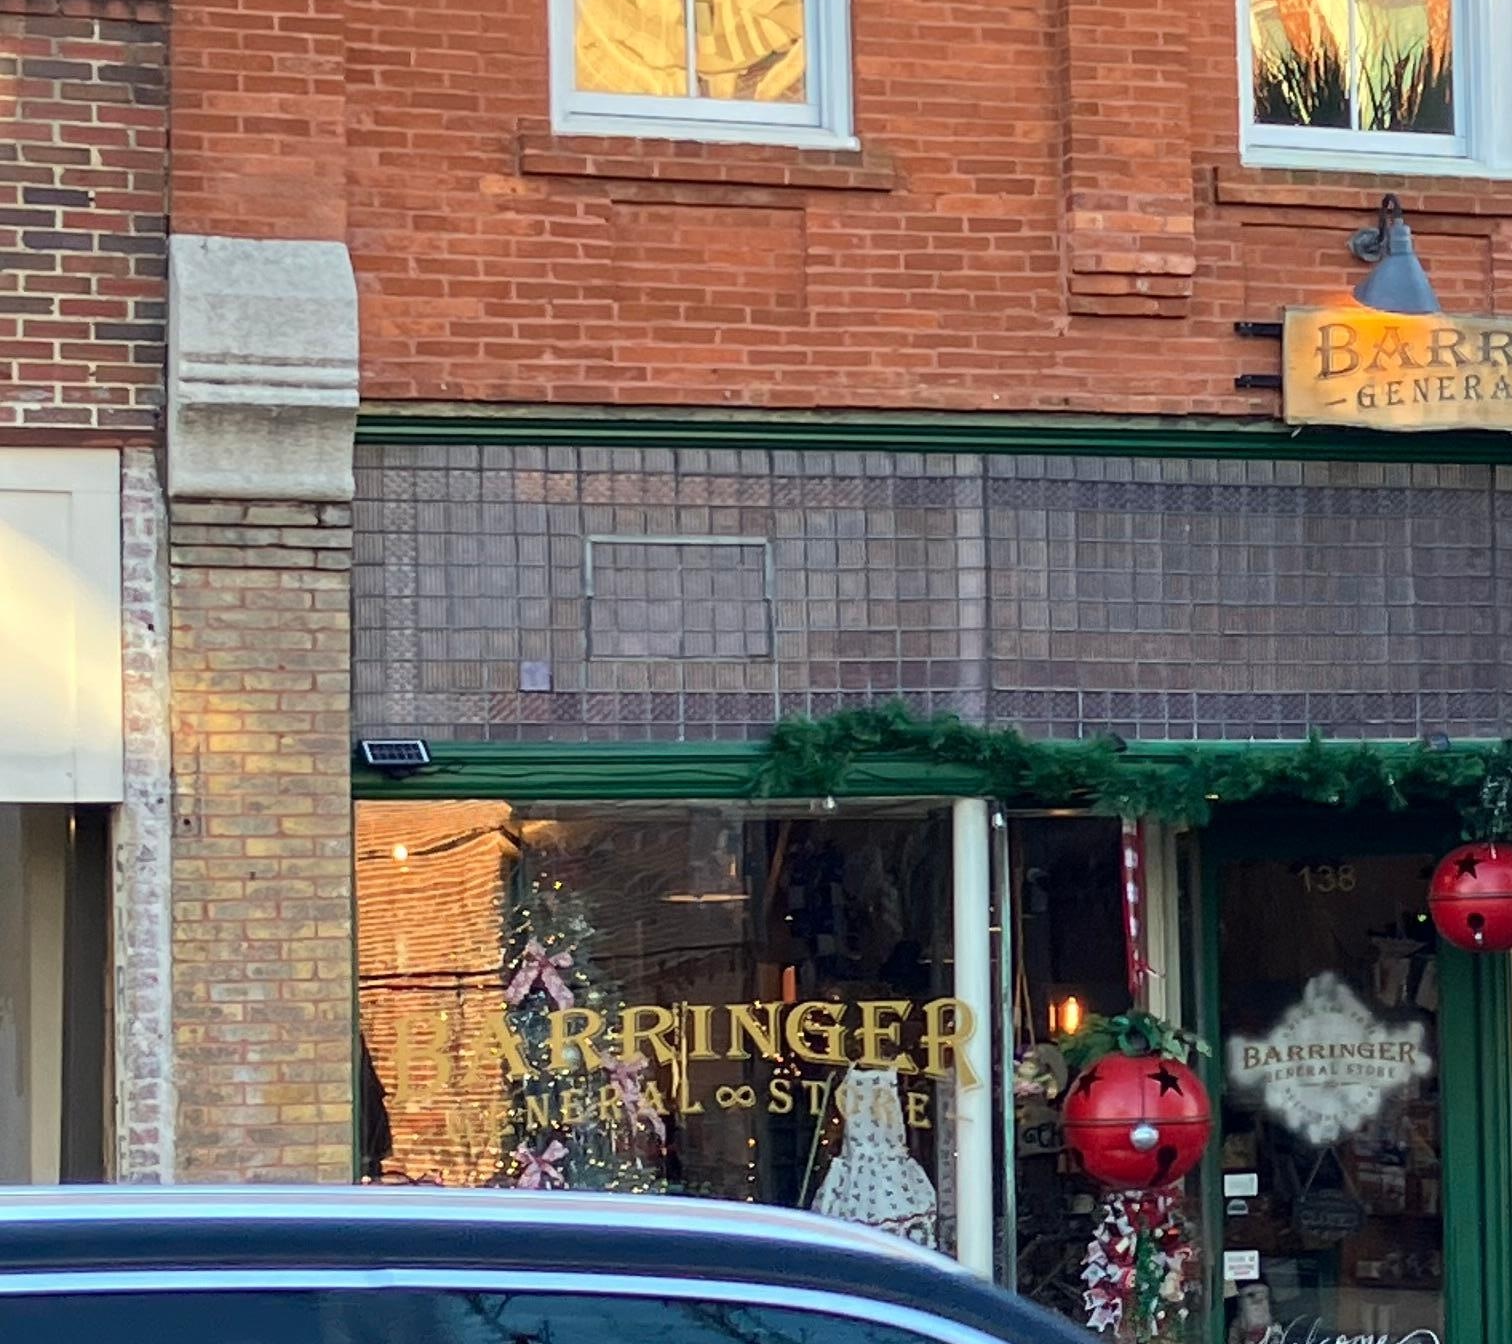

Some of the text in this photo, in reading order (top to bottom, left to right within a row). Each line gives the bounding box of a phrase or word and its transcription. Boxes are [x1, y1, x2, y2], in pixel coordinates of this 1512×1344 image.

[1298, 864, 1357, 893] 138
[392, 997, 982, 1103] BARRINGER
[1243, 1041, 1417, 1070] BARRINGER
